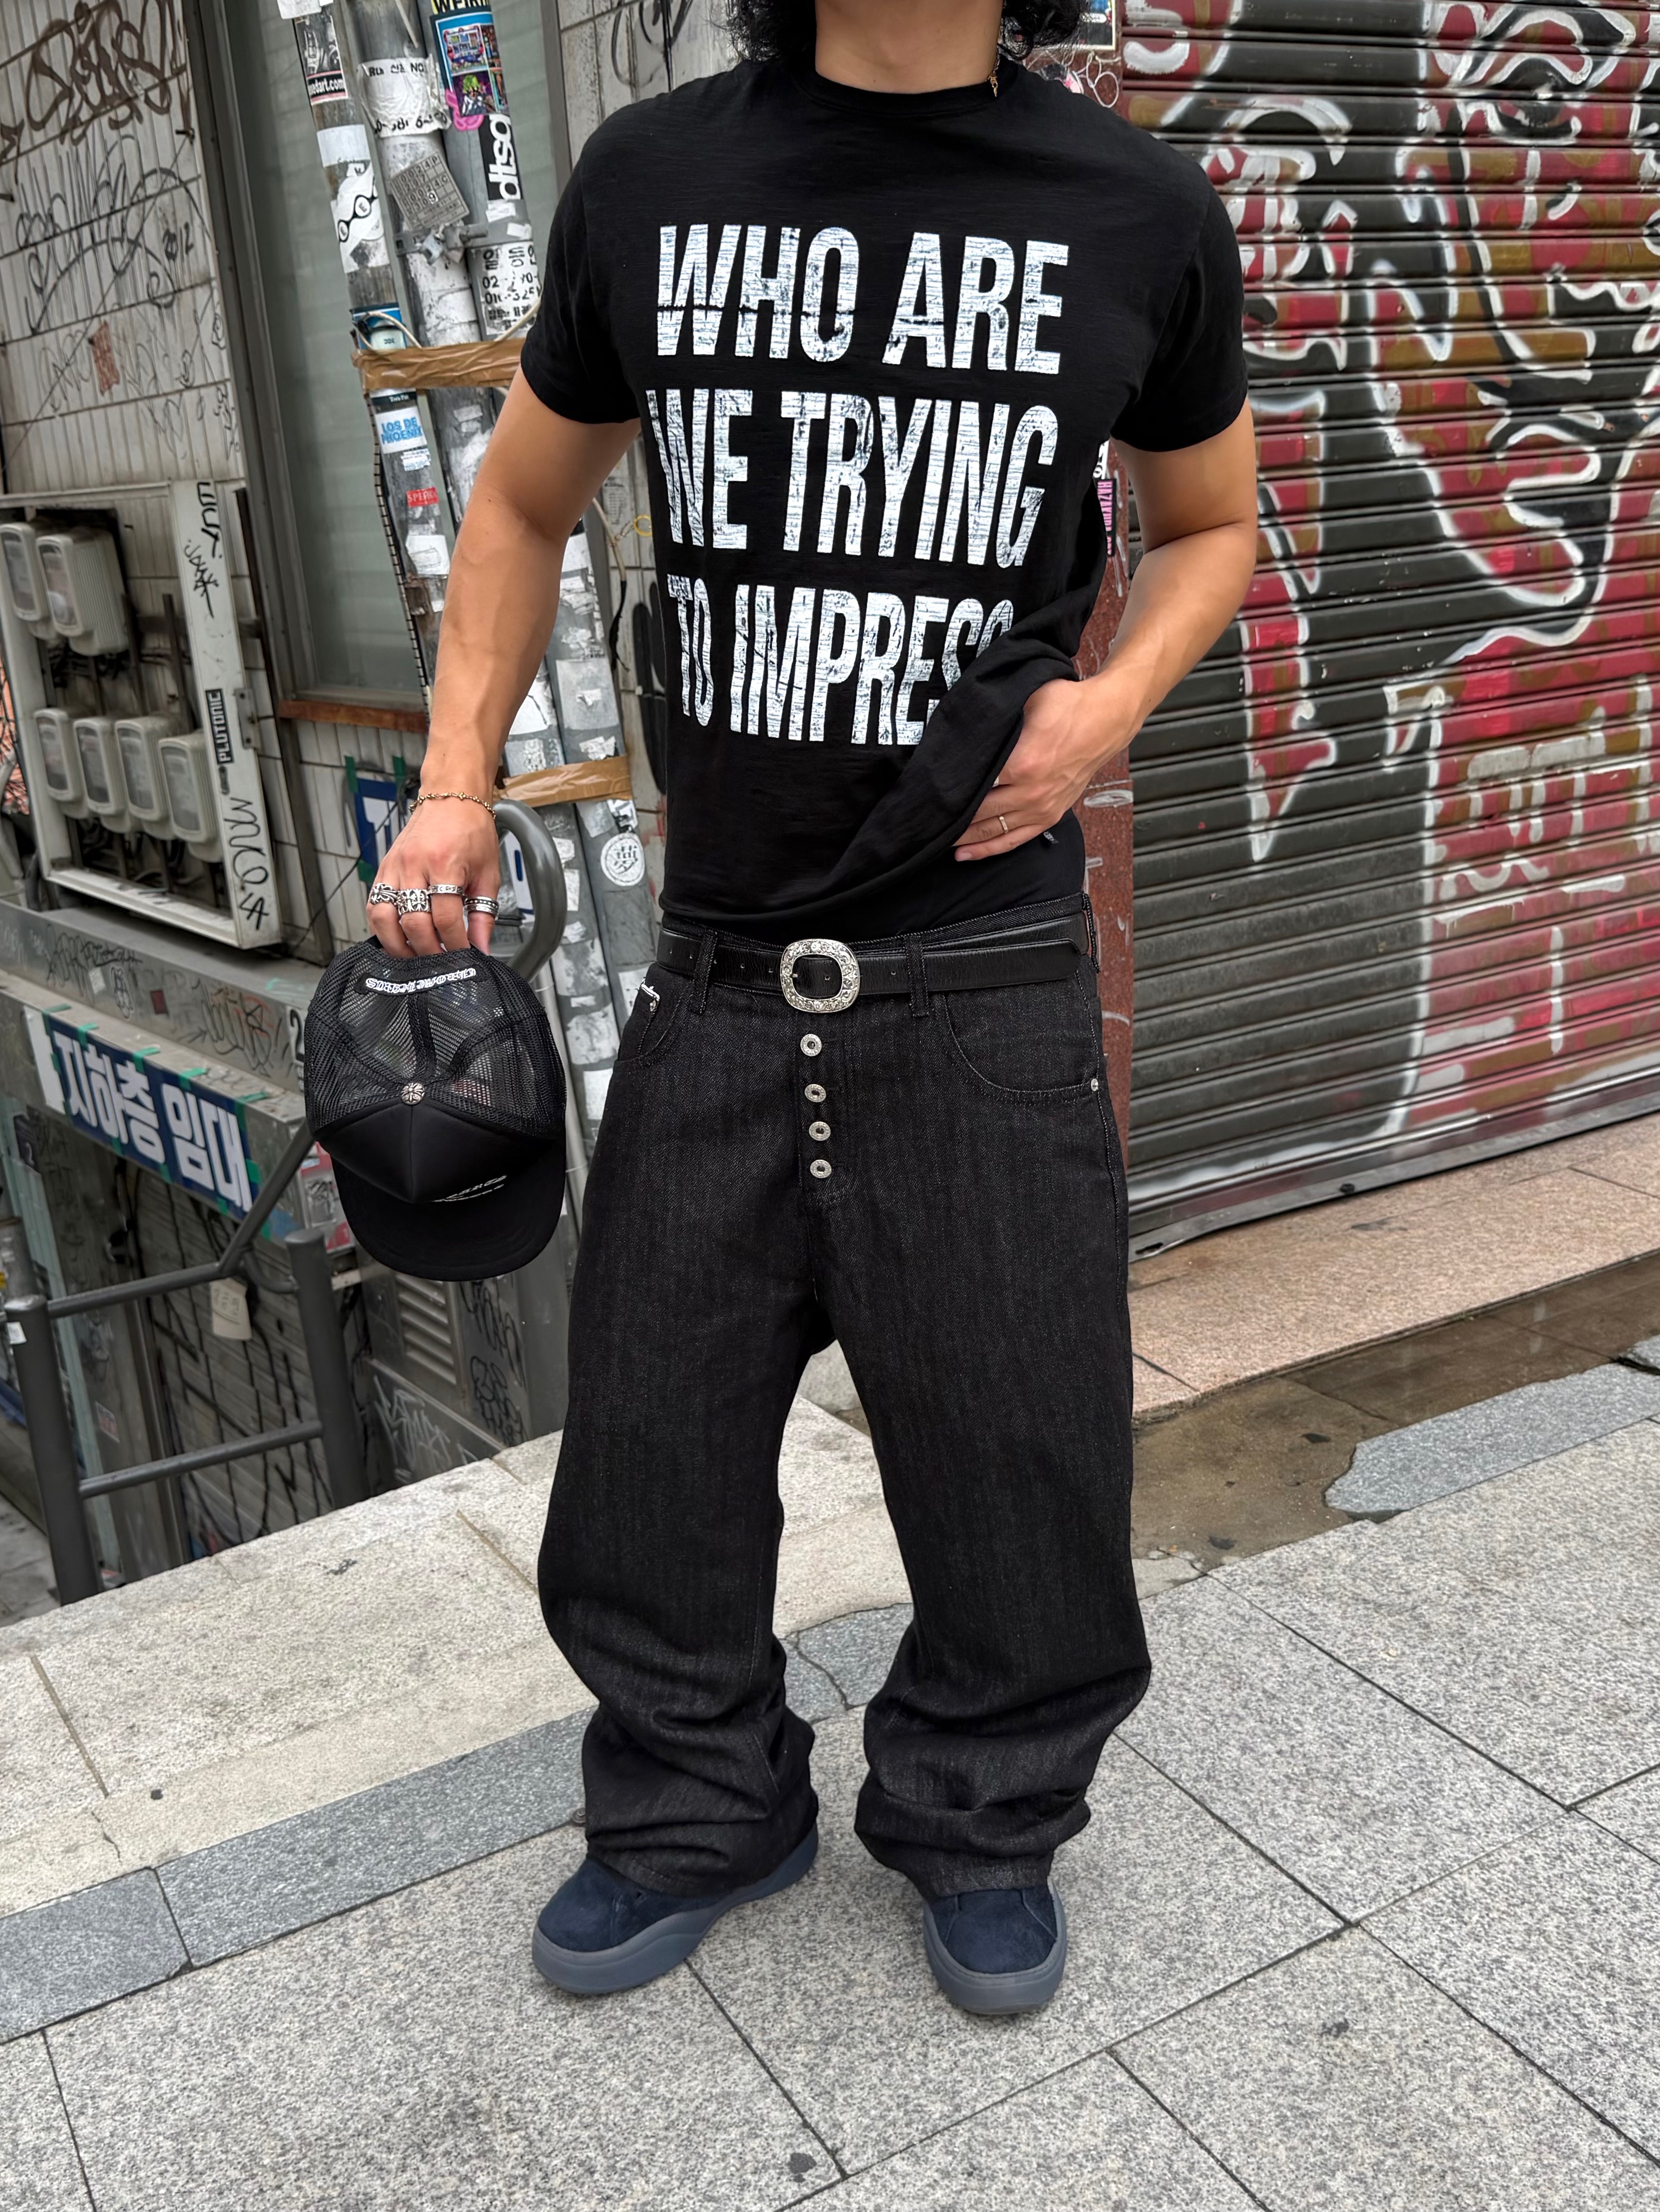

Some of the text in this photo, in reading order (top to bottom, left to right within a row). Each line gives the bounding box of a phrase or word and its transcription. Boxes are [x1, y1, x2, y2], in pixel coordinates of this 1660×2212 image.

[657, 224, 1069, 374] WHO ARE
[646, 389, 1059, 569] WE TRYING
[667, 575, 713, 726] TO
[209, 692, 232, 762] PLUTONIC
[53, 1030, 165, 1163] 지하층
[161, 1083, 252, 1212] 임대
